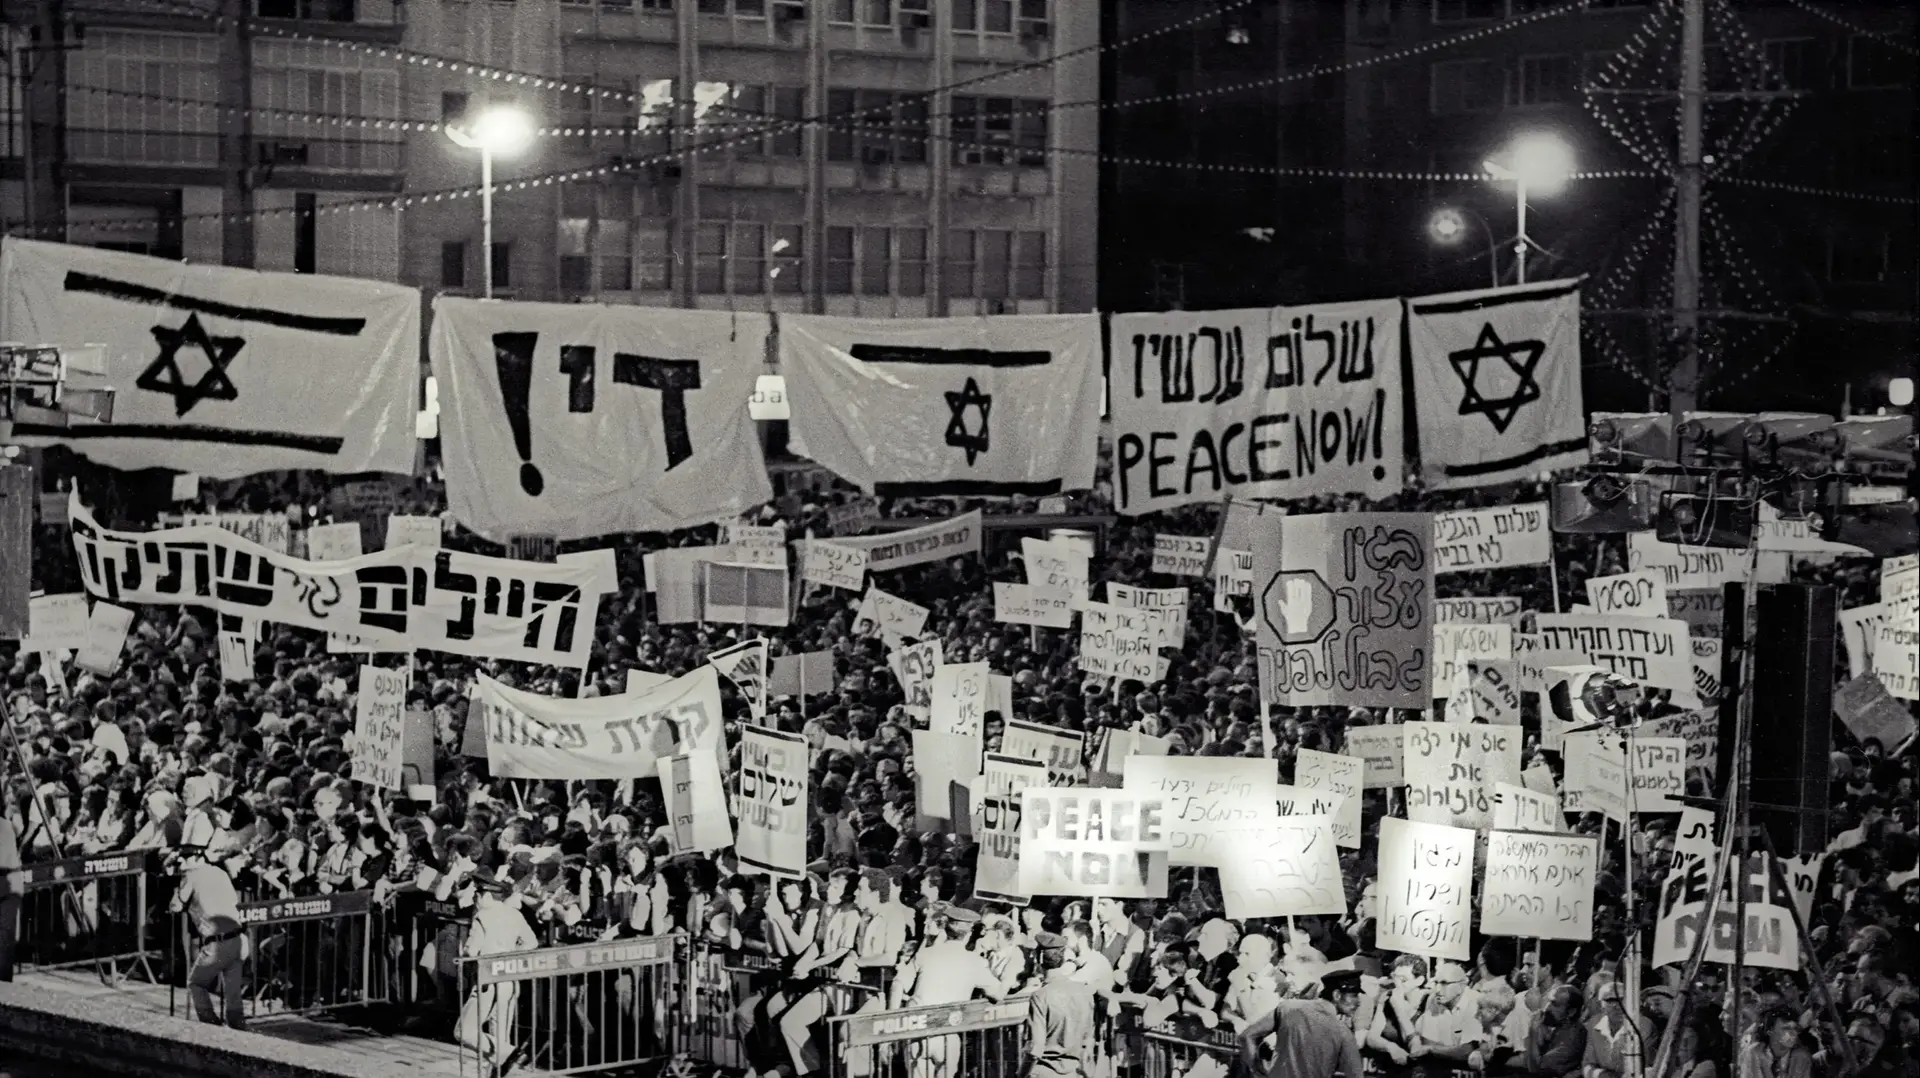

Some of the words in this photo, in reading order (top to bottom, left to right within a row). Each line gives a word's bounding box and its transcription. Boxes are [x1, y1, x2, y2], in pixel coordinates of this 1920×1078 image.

[1132, 325, 1244, 405] עכשיו
[1265, 314, 1374, 391] שלום
[492, 332, 701, 496] די!
[1117, 413, 1290, 509] PEACE
[1294, 388, 1386, 481] NOW!
[1493, 507, 1541, 534] שלום
[1344, 525, 1425, 581] בגין
[1478, 535, 1503, 564] לא
[1133, 590, 1186, 608] בטחון
[1336, 570, 1425, 630] עצור
[1542, 626, 1612, 655] חקירה
[1617, 627, 1674, 657] ועדת
[1258, 629, 1341, 705] לפניך
[1338, 624, 1424, 692] גבול
[1411, 726, 1441, 757] רצח
[1450, 731, 1471, 759] מי
[1481, 732, 1507, 753] אז
[1635, 744, 1681, 769] הקץ
[1448, 763, 1483, 782] את
[742, 767, 804, 808] שלום
[984, 779, 1022, 833] לום
[1028, 797, 1162, 842] PEACE
[1412, 838, 1462, 870] בגין
[1552, 842, 1591, 858] חברי
[84, 857, 129, 874] משטרה
[1043, 849, 1150, 886] NOW
[1545, 866, 1585, 888] אתם
[1406, 878, 1462, 906] ושרון
[239, 907, 268, 922] LICE
[284, 899, 332, 917] משטרה
[1556, 896, 1581, 924] לכו
[1673, 911, 1782, 956] NOW
[491, 951, 559, 977] POLICE
[743, 954, 783, 971] POLIE
[872, 1014, 928, 1036] POLICE
